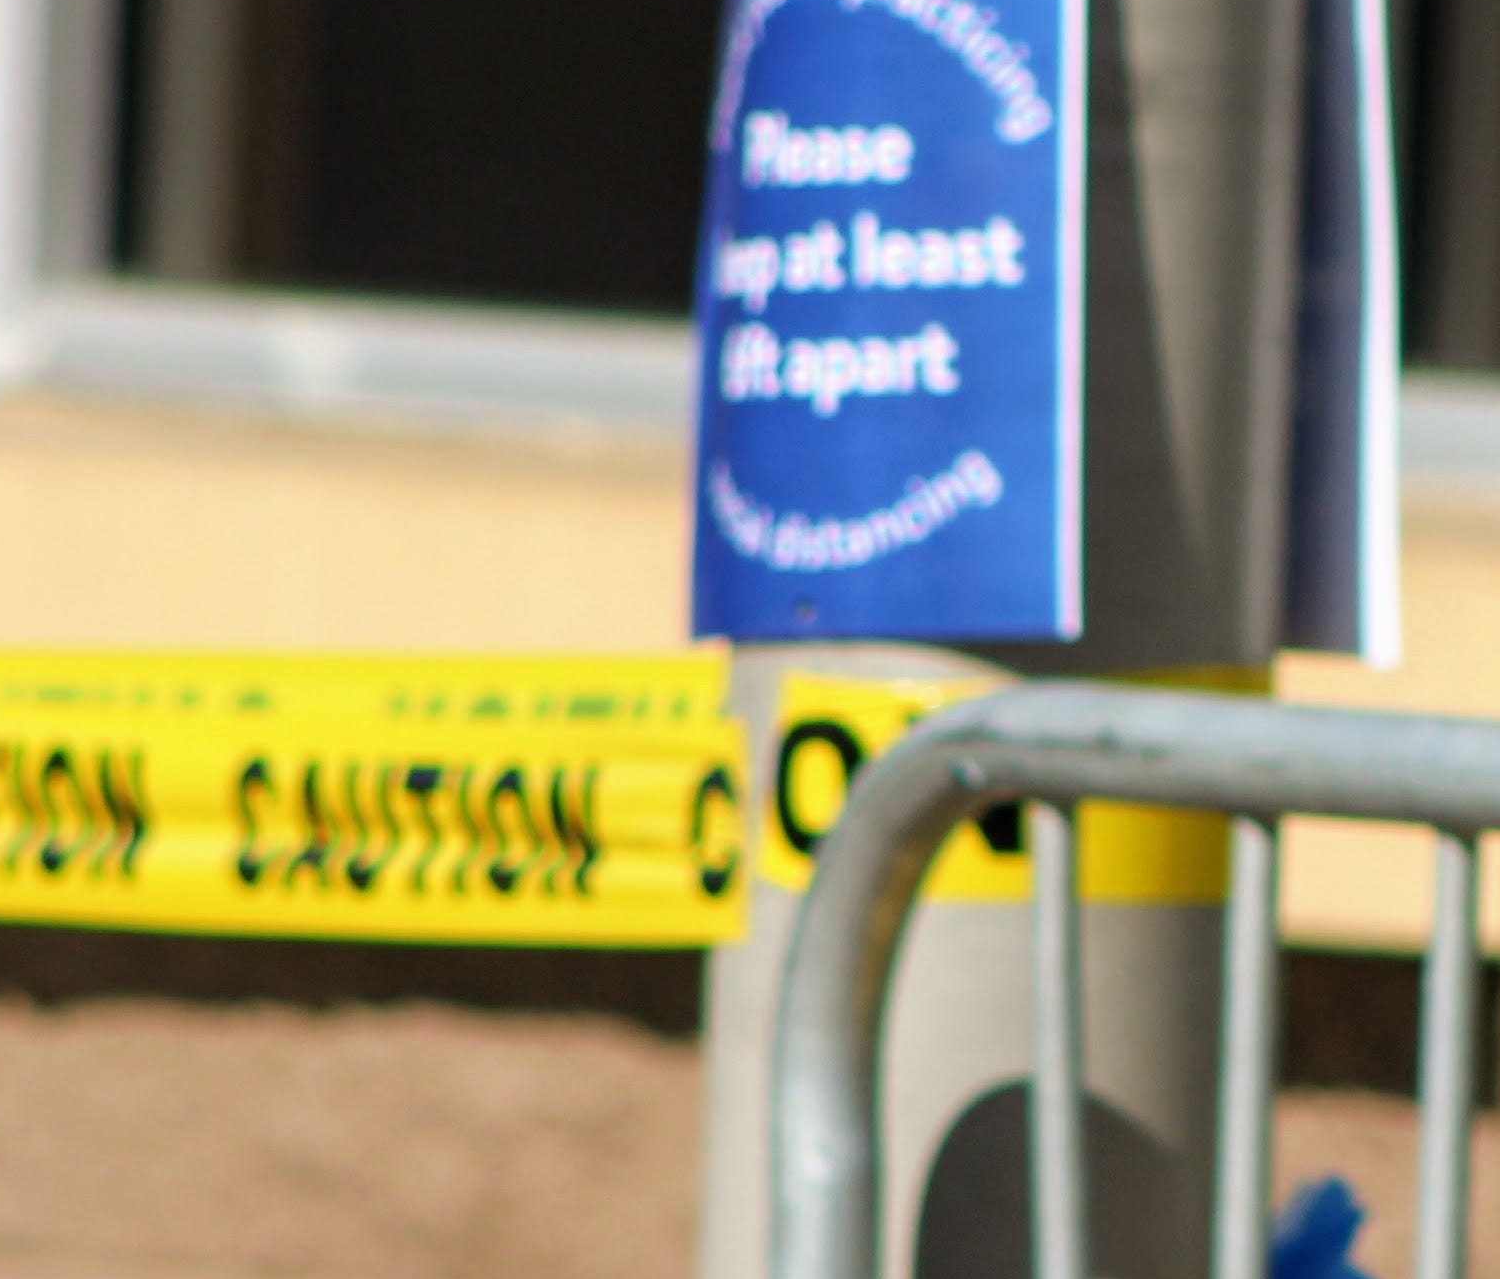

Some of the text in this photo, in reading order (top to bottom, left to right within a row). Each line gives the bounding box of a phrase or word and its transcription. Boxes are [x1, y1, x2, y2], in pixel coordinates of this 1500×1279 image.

[743, 109, 914, 188] Please
[783, 219, 846, 291] at
[853, 209, 1025, 290] least
[785, 320, 960, 417] apart
[770, 448, 1004, 573] distancing
[235, 756, 599, 897] CAUTION
